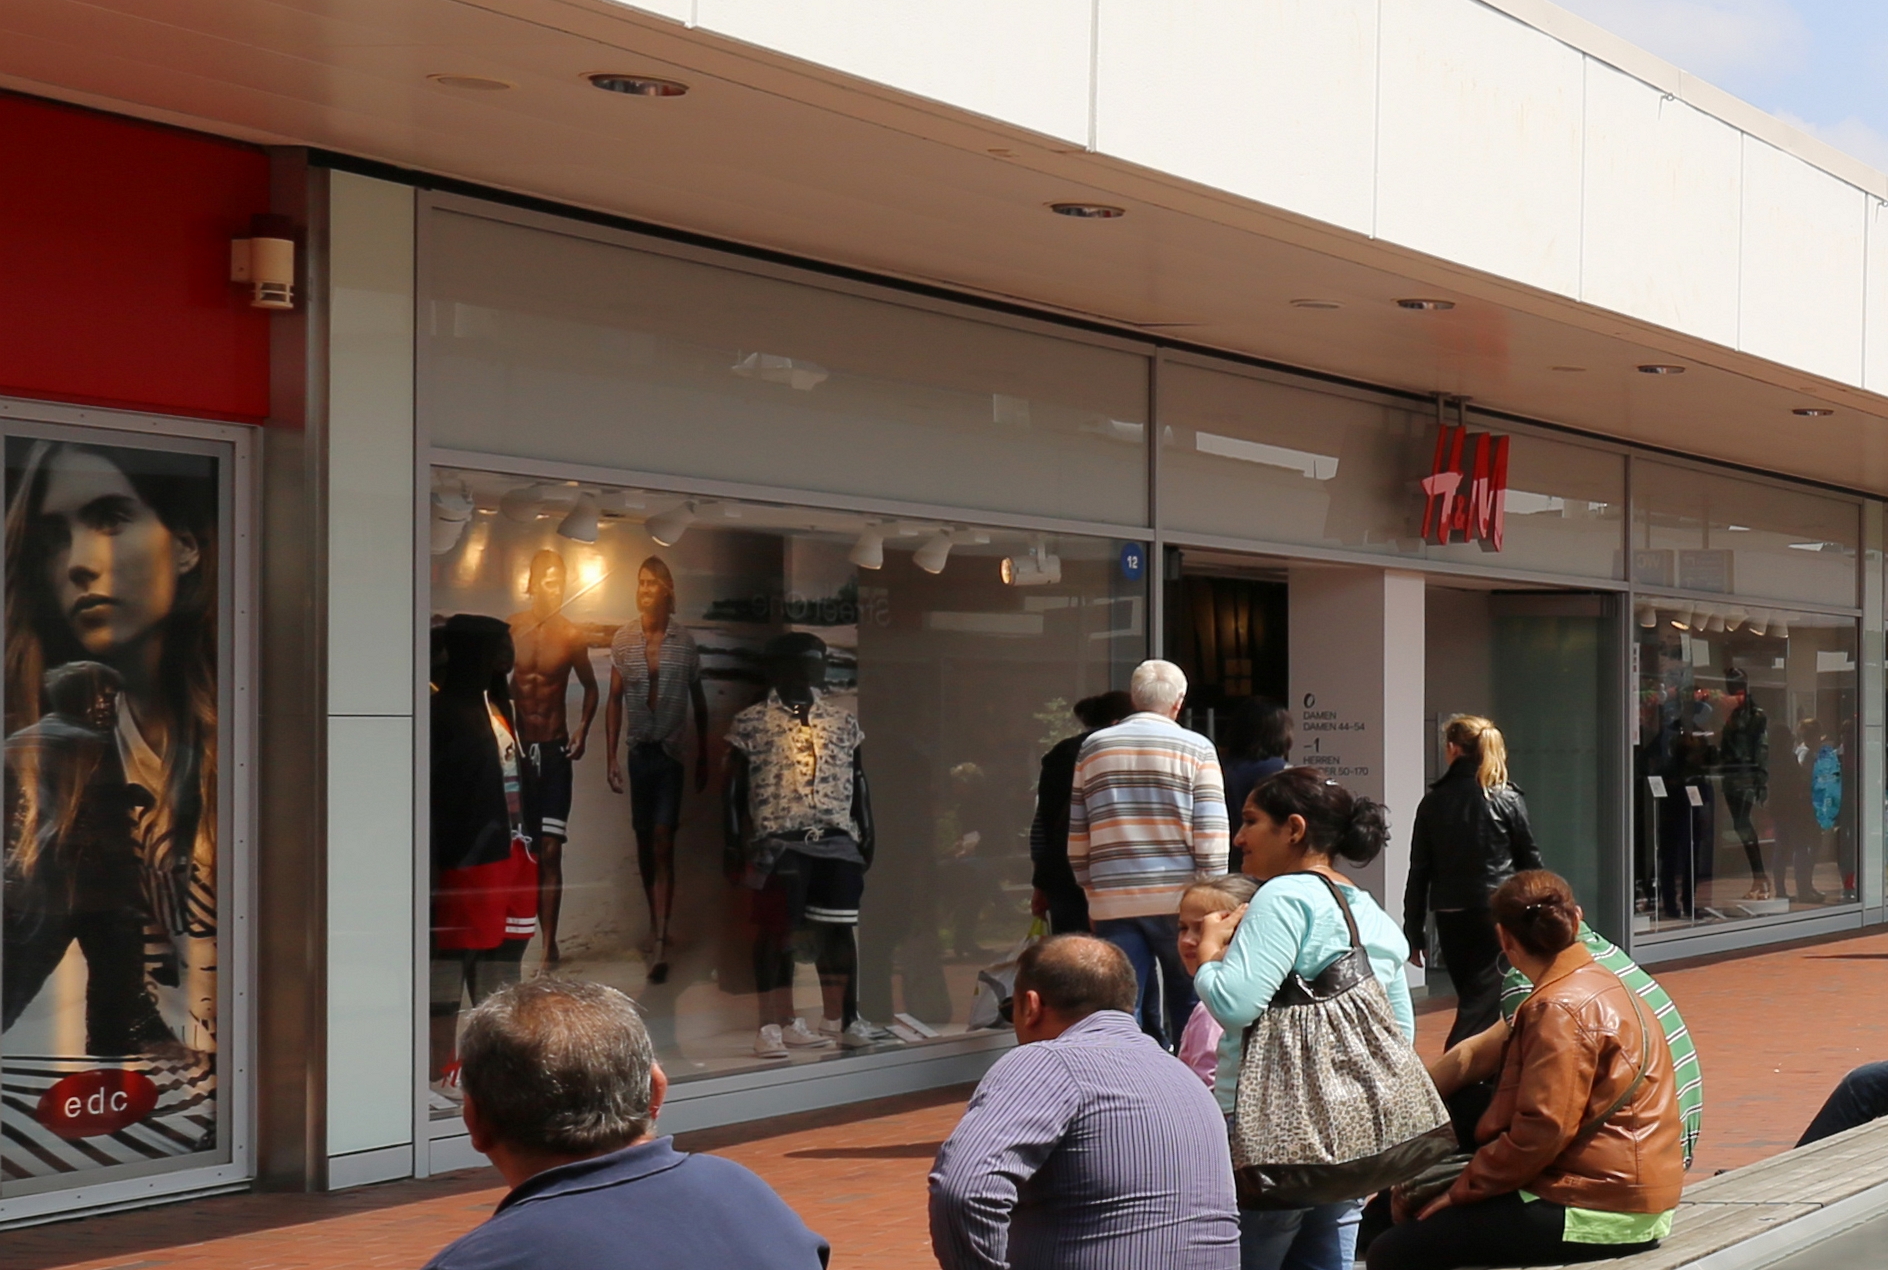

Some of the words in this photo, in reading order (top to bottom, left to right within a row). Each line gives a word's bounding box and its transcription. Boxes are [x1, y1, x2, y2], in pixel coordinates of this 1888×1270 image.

[1420, 424, 1509, 552] H&M
[1126, 555, 1139, 569] 12
[1303, 711, 1337, 720] DAMEN
[1303, 722, 1337, 731] DAMEN
[1303, 756, 1340, 765] HERREN
[64, 1086, 128, 1118] edc
